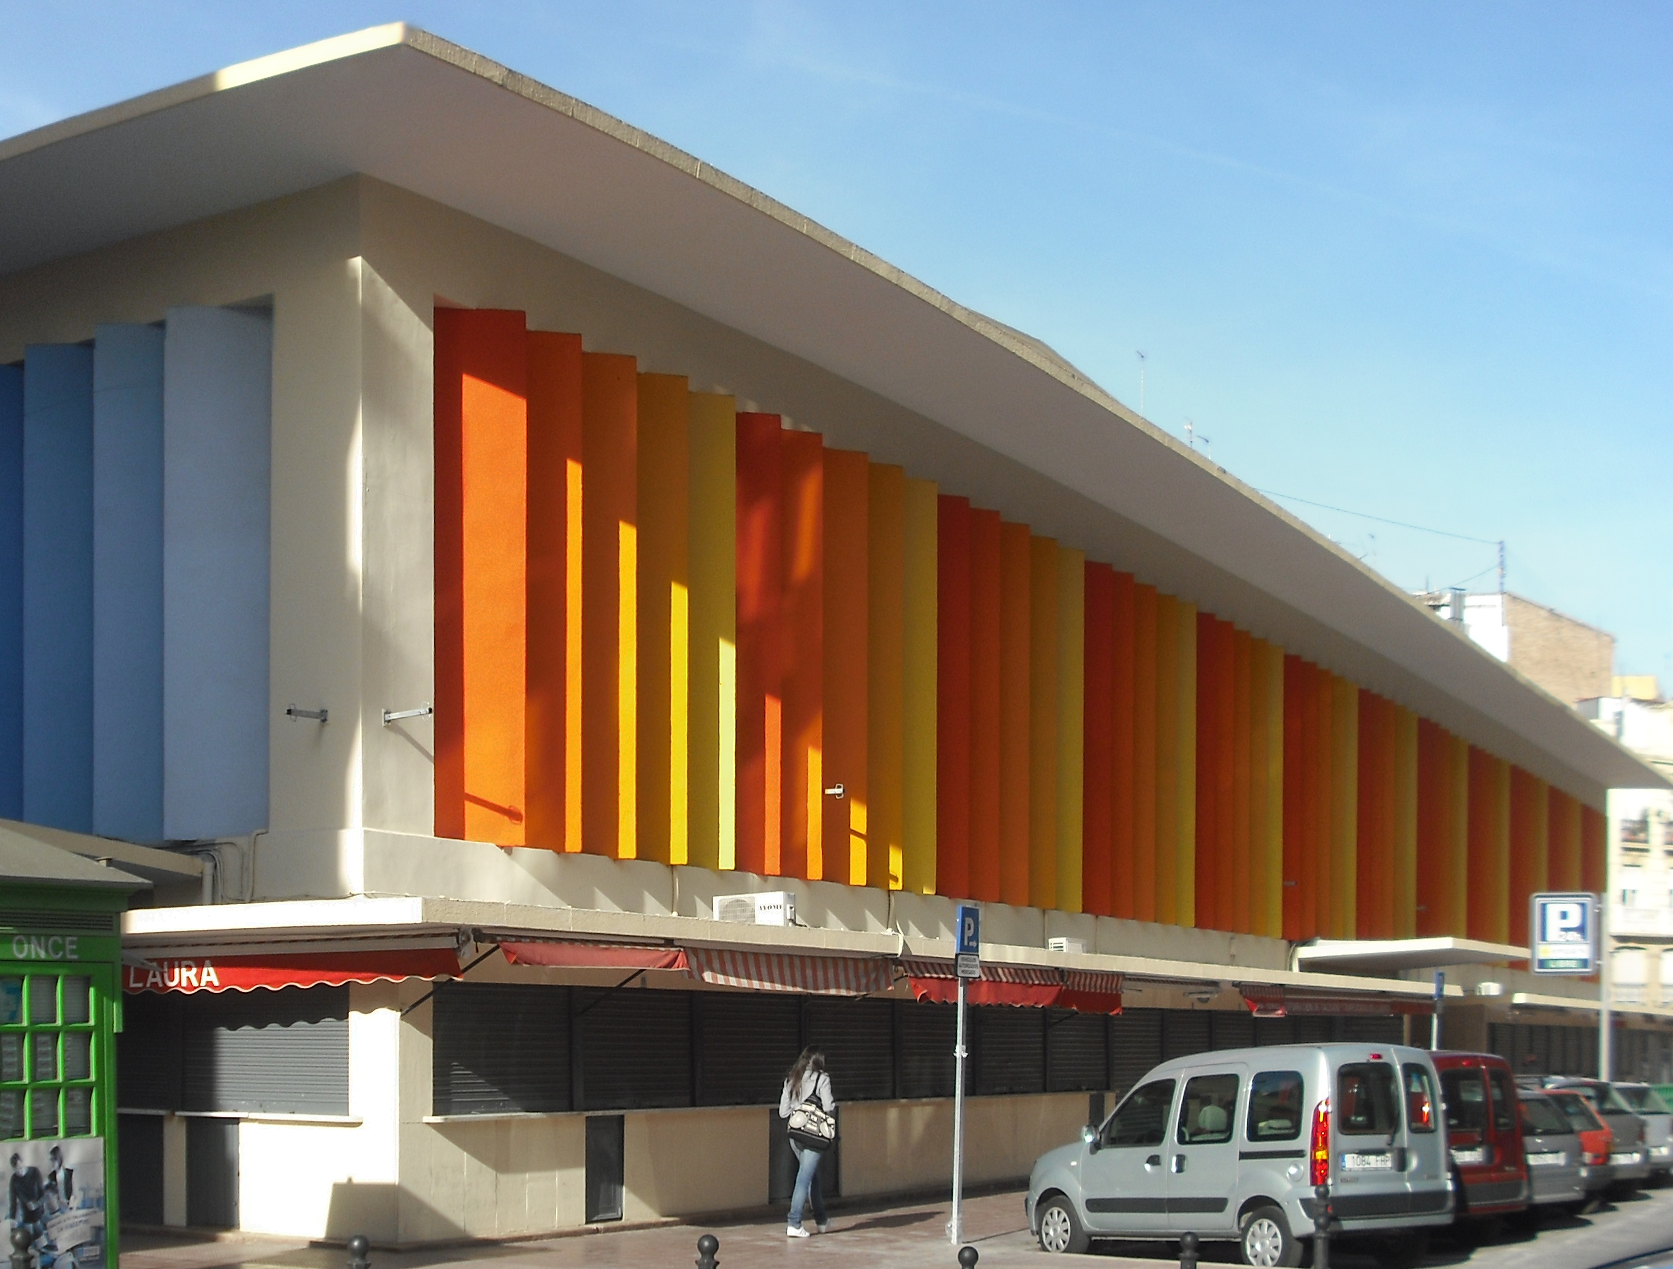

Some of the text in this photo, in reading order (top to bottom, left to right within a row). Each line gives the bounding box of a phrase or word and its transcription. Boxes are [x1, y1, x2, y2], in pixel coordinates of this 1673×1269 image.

[964, 917, 975, 946] P
[12, 935, 78, 960] ONCE
[129, 960, 220, 988] LAURA
